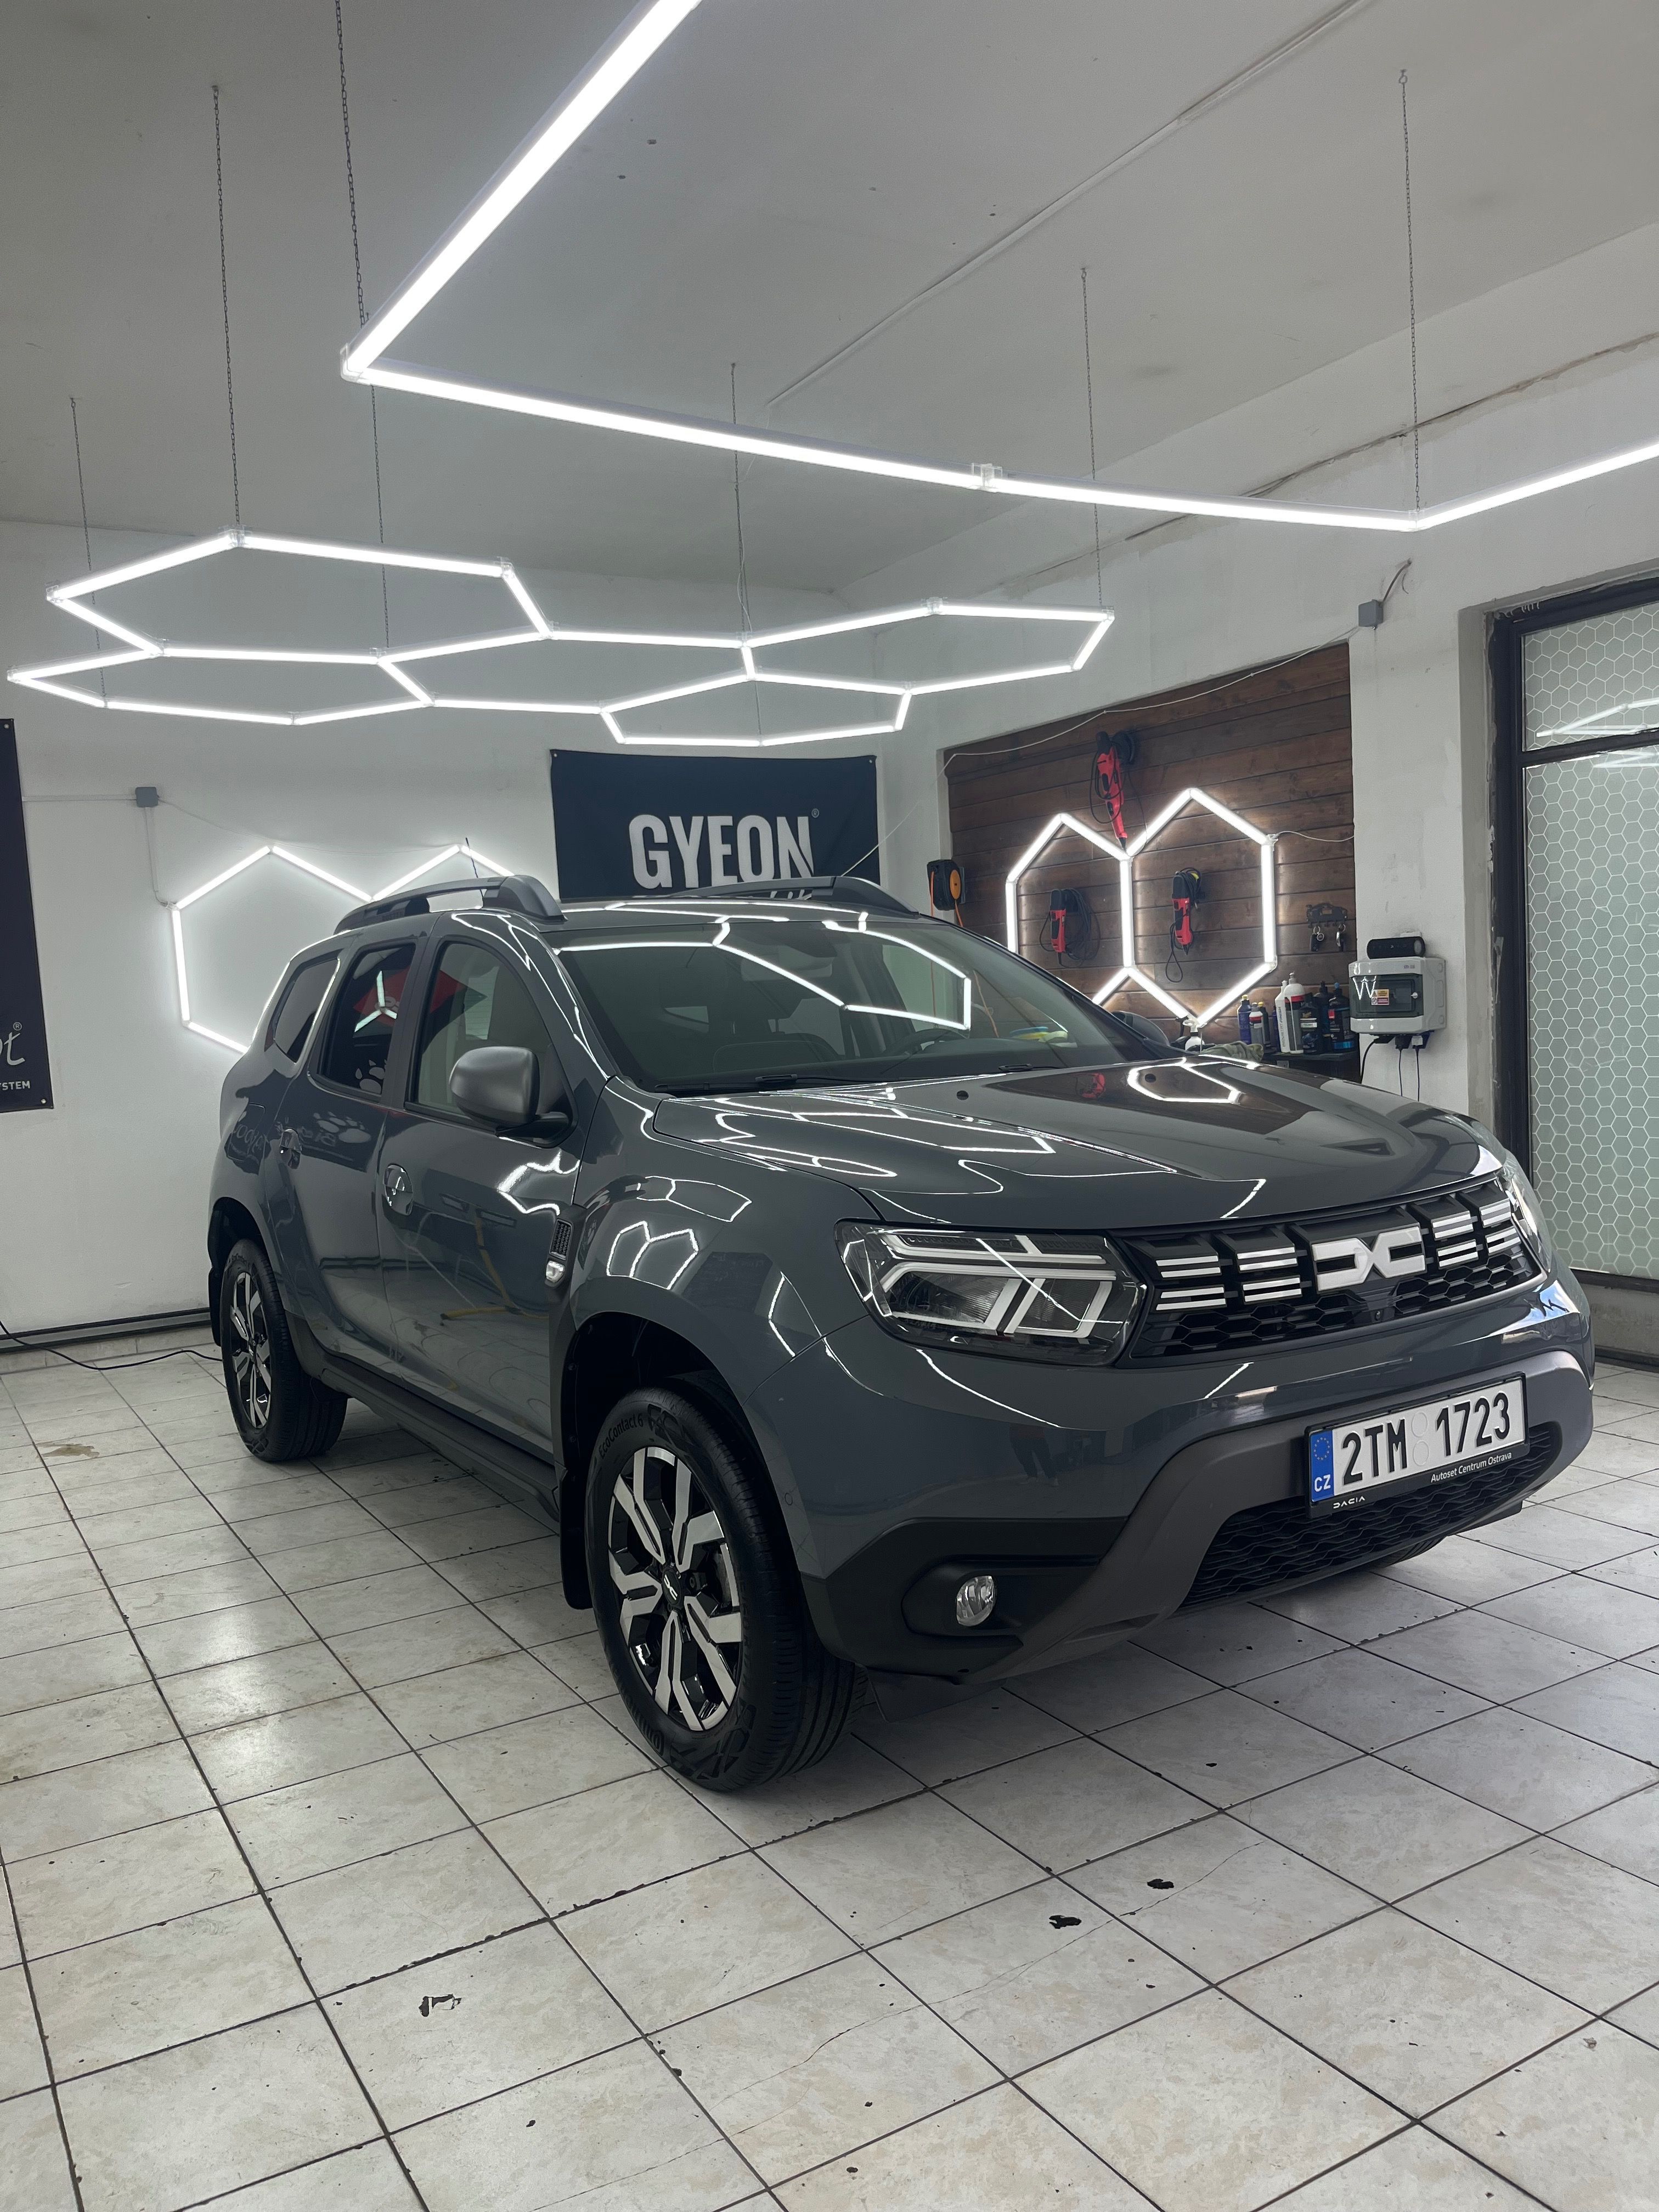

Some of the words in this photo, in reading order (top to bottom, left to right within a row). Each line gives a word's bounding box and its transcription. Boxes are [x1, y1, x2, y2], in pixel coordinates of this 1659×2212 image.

[629, 814, 814, 889] GYEON
[0, 1081, 31, 1091] STEM
[599, 1413, 637, 1459] EcoContact
[637, 1413, 644, 1427] 6
[1342, 1419, 1408, 1486] 2TM
[1436, 1392, 1510, 1457] 1723
[1314, 1474, 1331, 1492] CZ
[1431, 1468, 1457, 1483] Autoset
[1458, 1460, 1487, 1474] Centrum
[1488, 1452, 1512, 1465] Ostrava
[1333, 1496, 1365, 1509] DACIA
